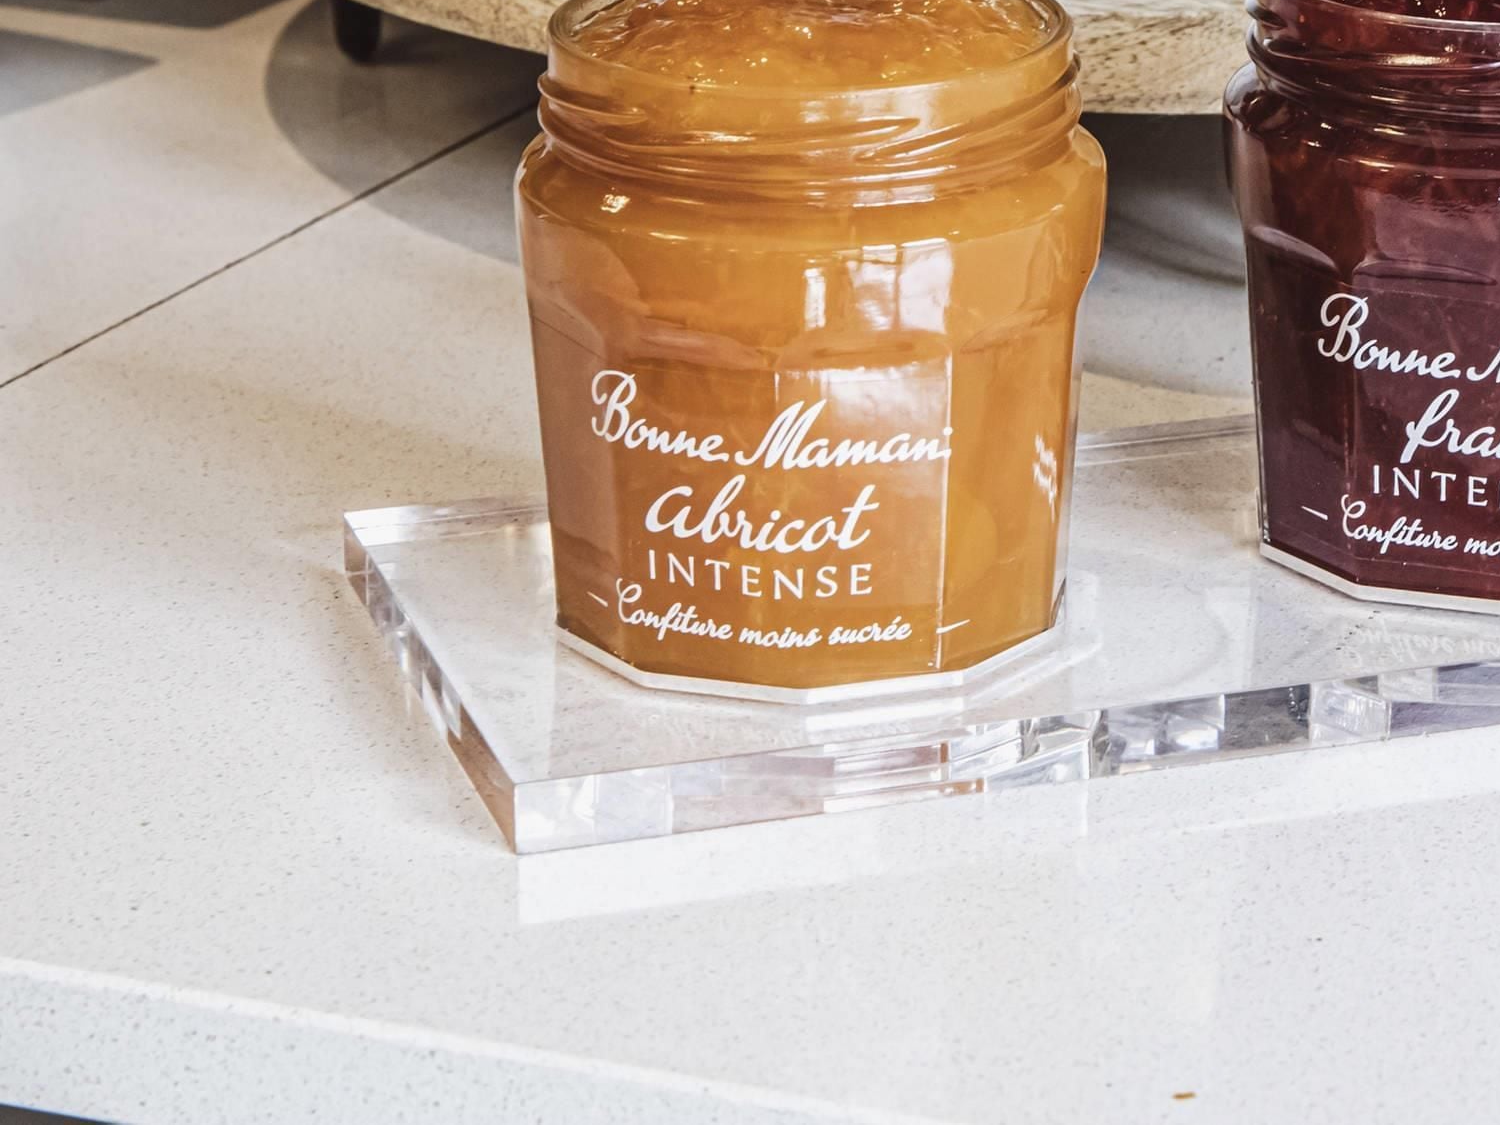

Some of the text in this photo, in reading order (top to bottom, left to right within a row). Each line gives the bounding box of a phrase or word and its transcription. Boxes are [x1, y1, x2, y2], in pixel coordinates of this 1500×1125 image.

[1318, 293, 1461, 378] Bonne
[591, 369, 728, 462] Bonne
[1341, 494, 1458, 555] Confiture
[648, 550, 873, 600] INTENSE
[615, 577, 912, 649] Confiture moins sucrée
